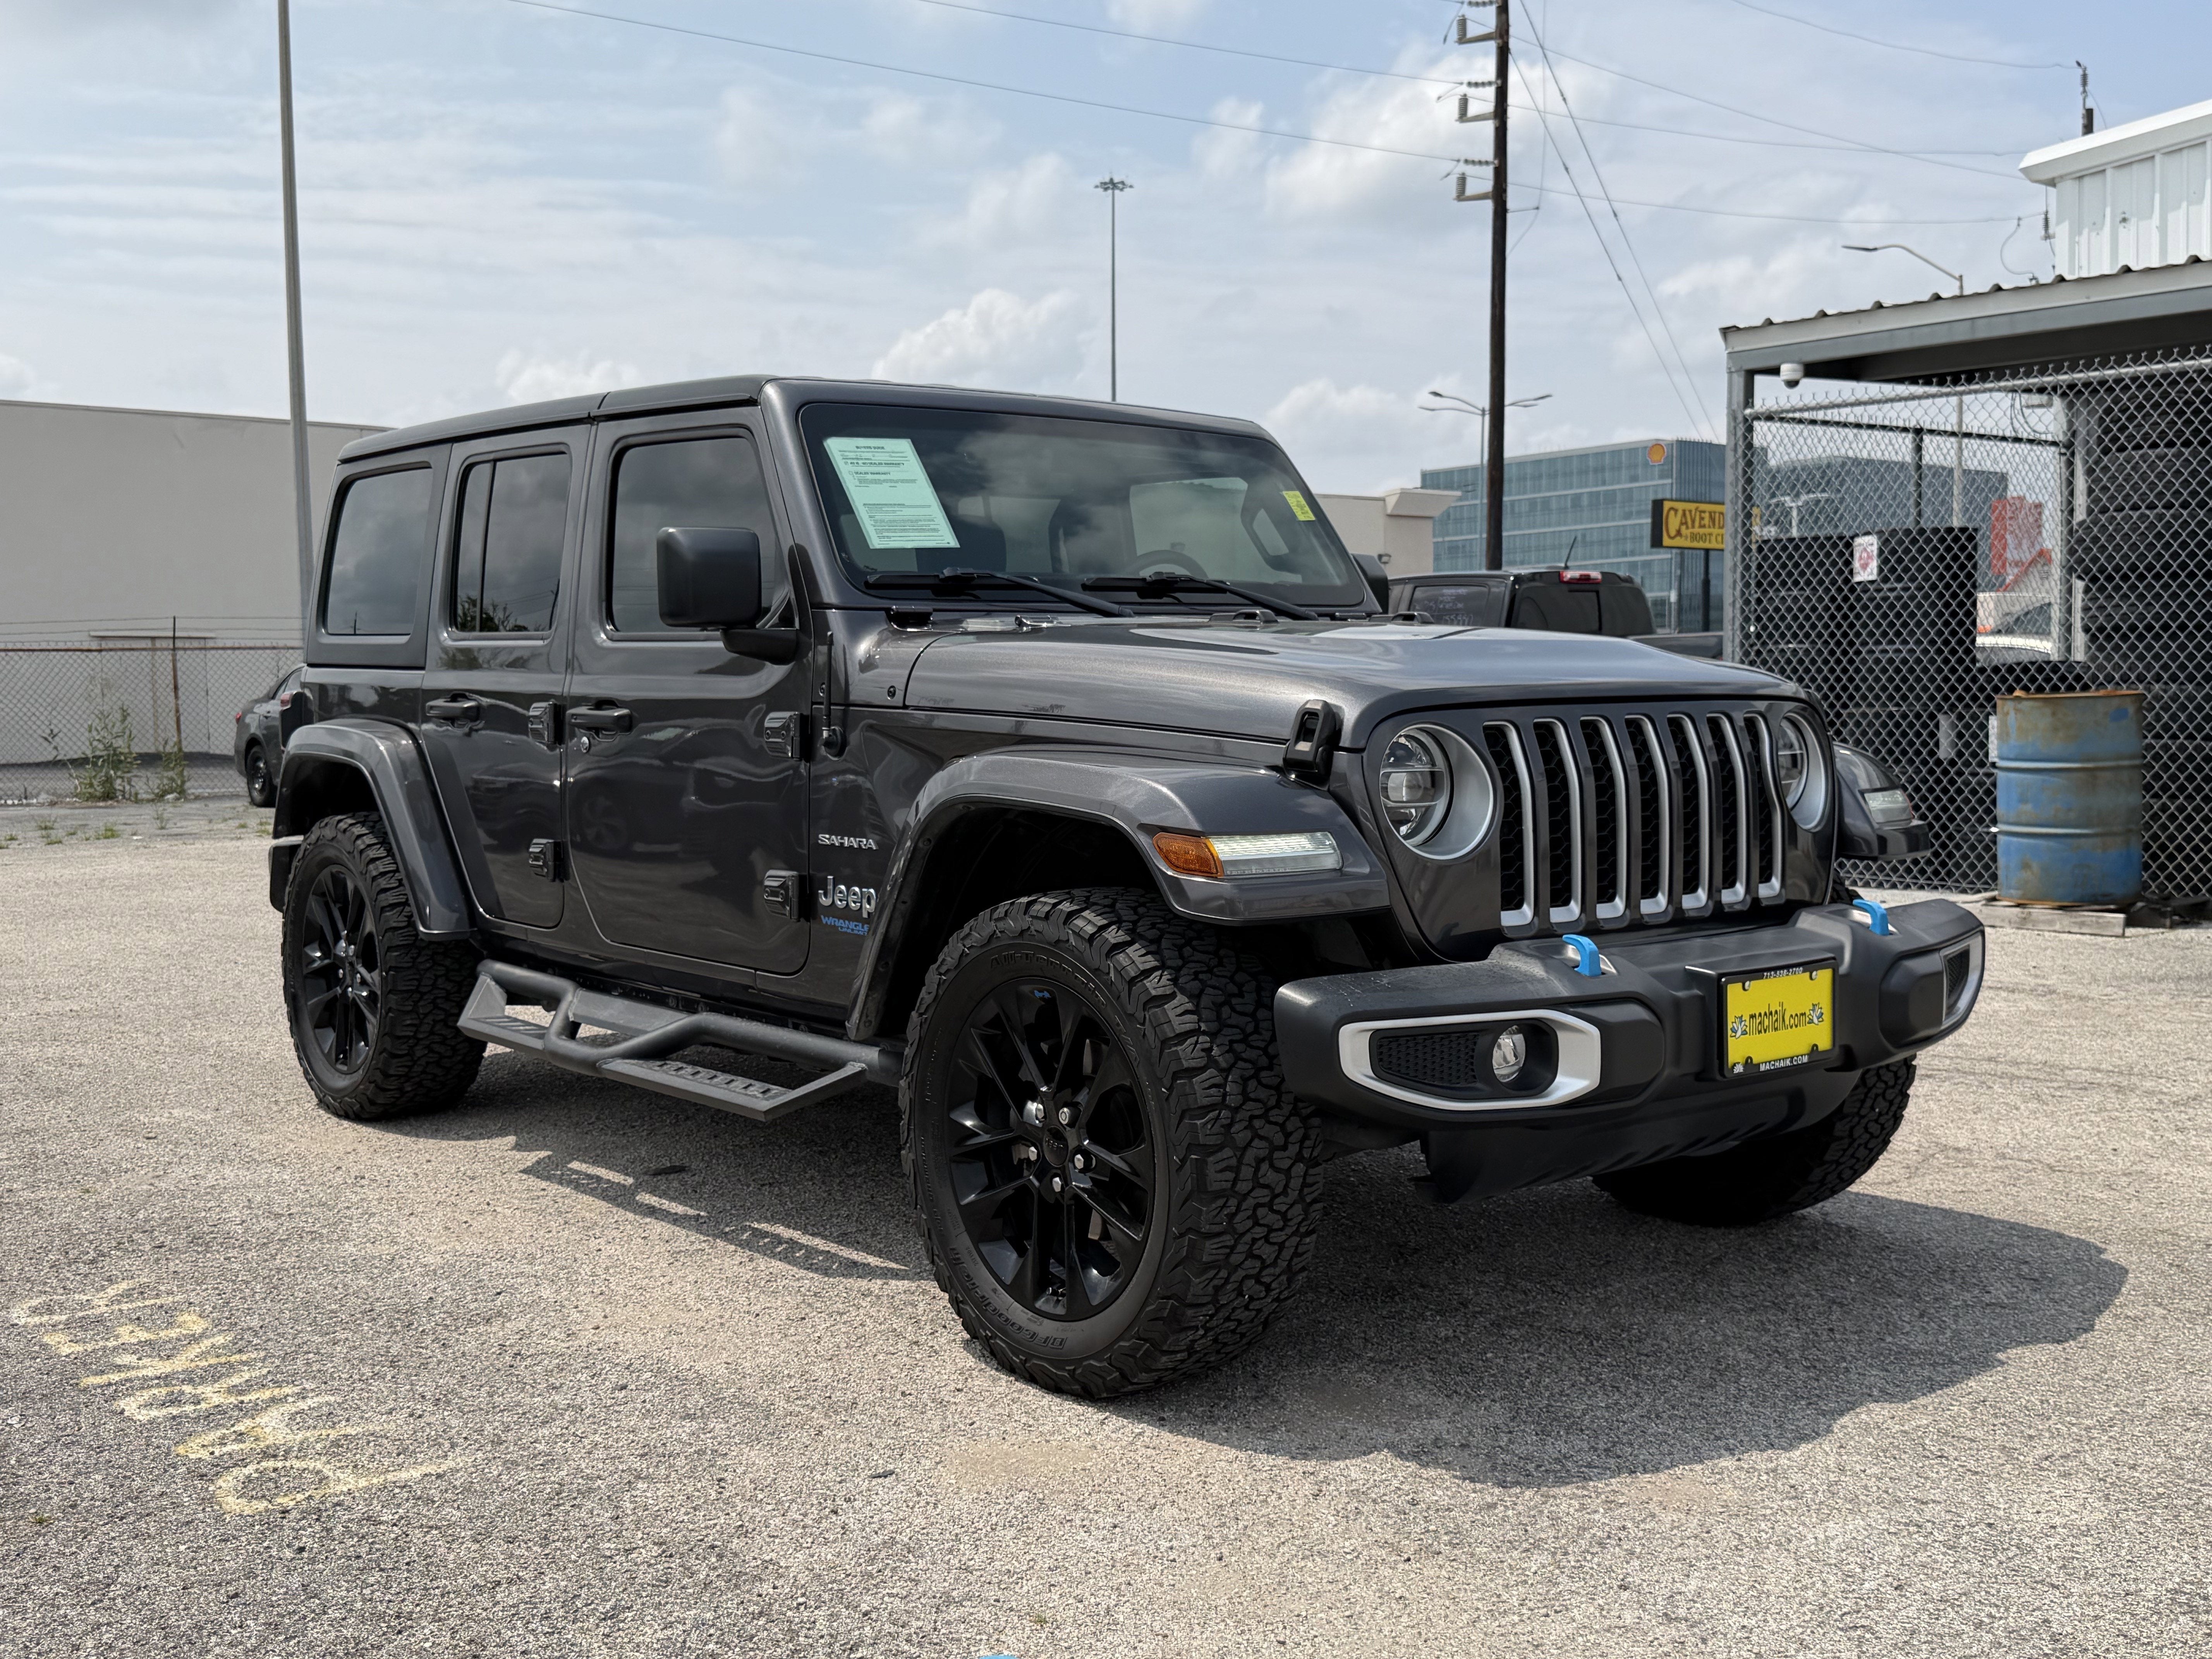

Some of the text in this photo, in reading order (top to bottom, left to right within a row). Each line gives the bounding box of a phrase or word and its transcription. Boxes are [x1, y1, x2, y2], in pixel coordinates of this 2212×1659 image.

[1690, 532, 1713, 544] BOOT
[818, 834, 879, 850] SAHARA
[818, 876, 876, 918] Jeep
[1748, 1001, 1807, 1036] machaik.com
[1760, 1055, 1808, 1072] MACHAIK.COM
